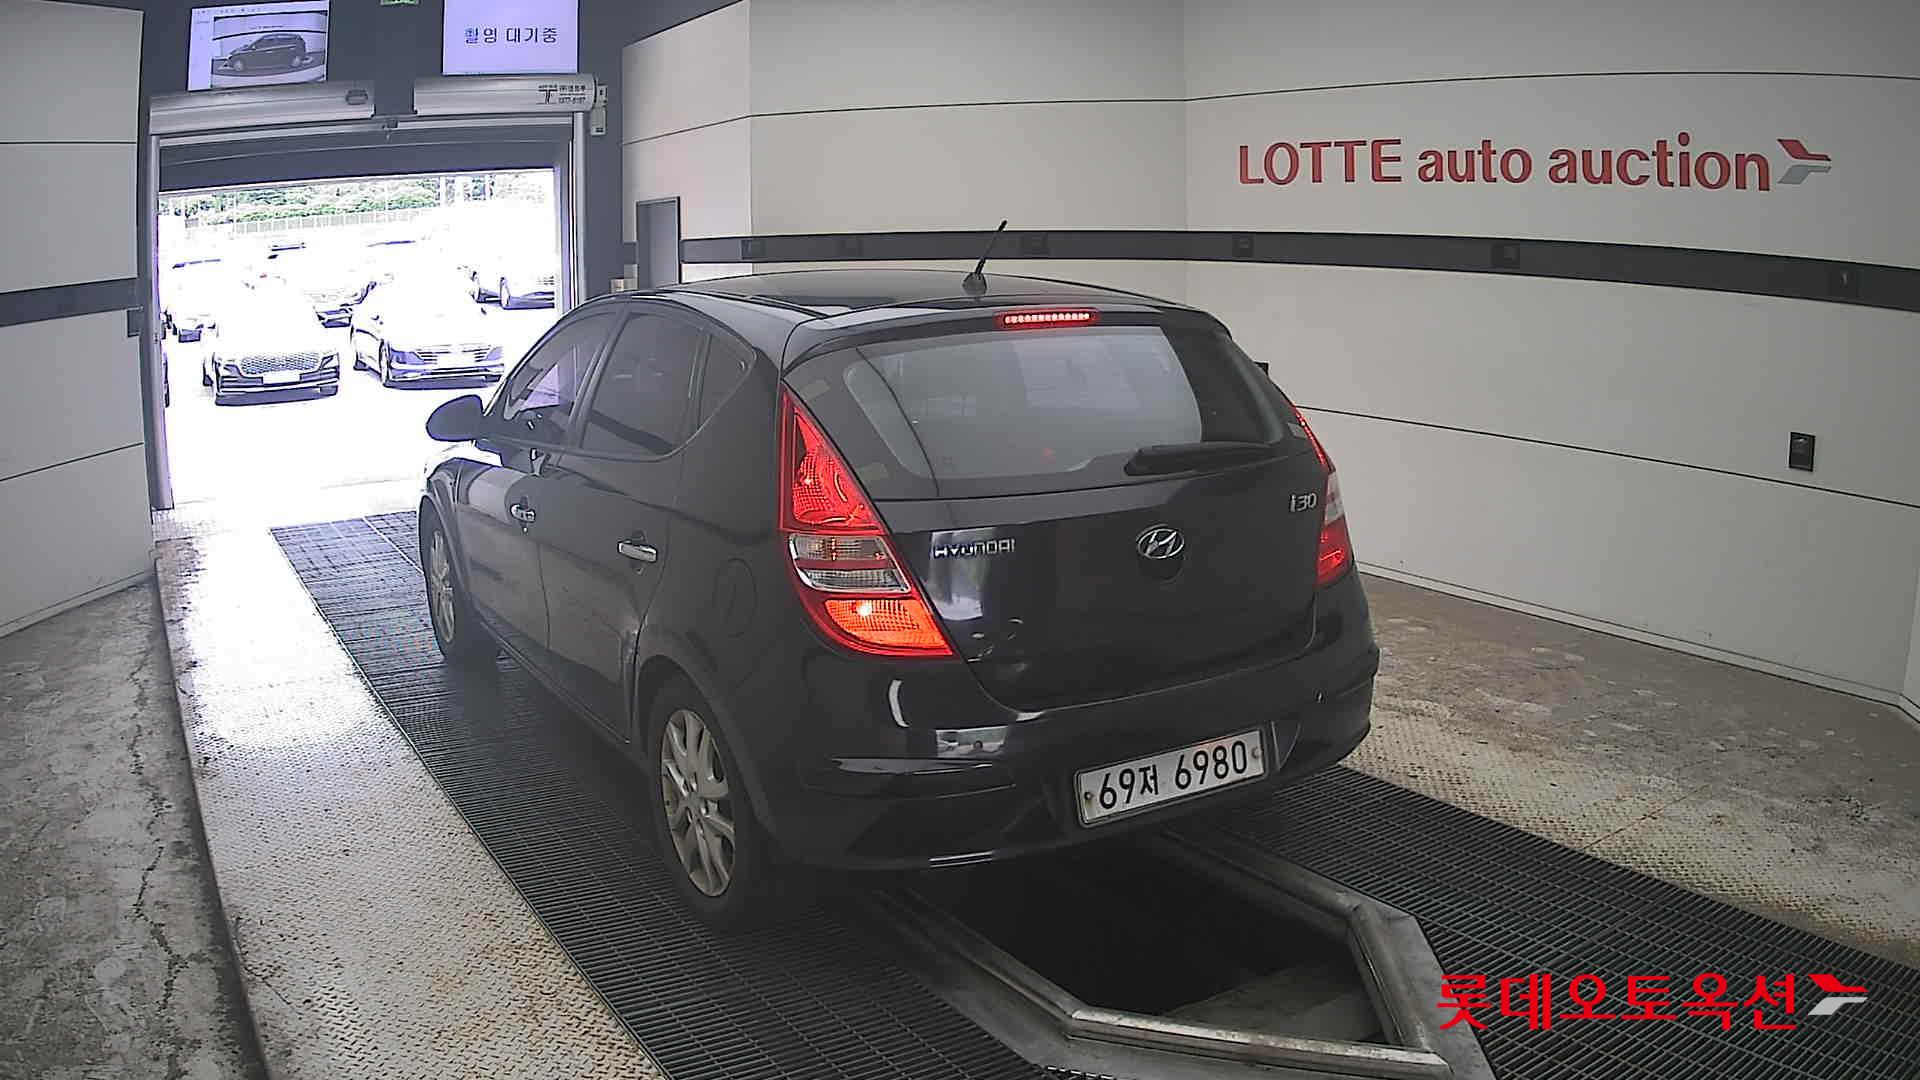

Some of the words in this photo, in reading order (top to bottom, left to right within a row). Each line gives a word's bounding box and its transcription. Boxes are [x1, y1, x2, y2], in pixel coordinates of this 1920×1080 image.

[506, 27, 558, 43] 대기중
[1238, 139, 1402, 185] LOTTE
[1417, 139, 1533, 184] auto
[1548, 132, 1771, 192] auction
[934, 538, 1016, 558] HYUNDAI
[1099, 763, 1159, 810] 69저
[1174, 740, 1248, 790] 6980
